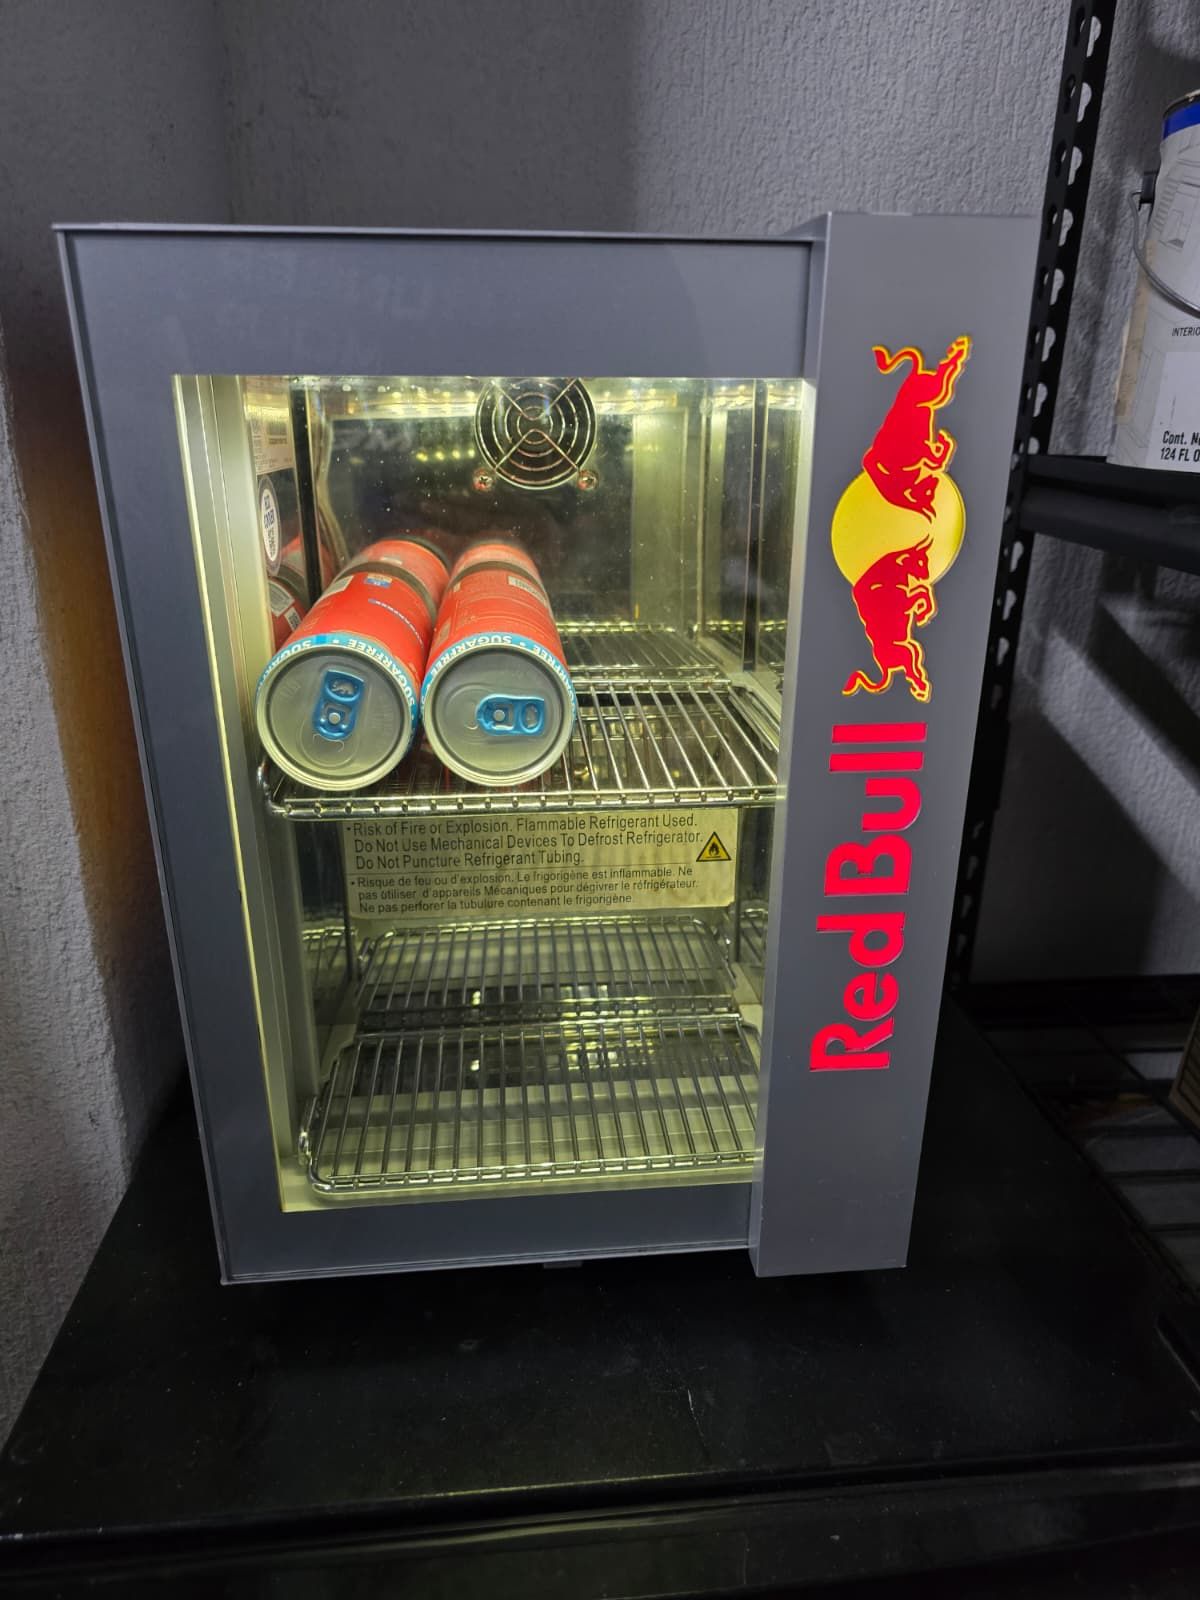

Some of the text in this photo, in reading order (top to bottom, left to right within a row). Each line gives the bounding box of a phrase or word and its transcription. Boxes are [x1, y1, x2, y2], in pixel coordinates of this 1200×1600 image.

[1162, 430, 1188, 444] Cont.
[1160, 448, 1176, 460] 124
[1178, 448, 1190, 462] FL
[430, 635, 513, 677] SUGARFREE
[348, 638, 415, 706] SUGARFREE
[354, 814, 697, 836] Risk of Fire or Explosion. Flammable Refrigerant Used.
[354, 830, 704, 853] Do Not Use Mechanical Devices To Defrost Refrigerator.
[356, 850, 584, 870] Do Not Puncture Refrigerant Tubing.
[358, 876, 395, 889] Risque
[398, 876, 412, 886] de
[414, 875, 432, 886] feu
[434, 877, 448, 885] ou
[592, 870, 608, 879] est
[678, 866, 693, 876] Ne
[358, 892, 378, 900] pas
[550, 884, 574, 895] pour
[622, 880, 630, 890] le
[810, 721, 928, 1072] Red Bull
[360, 902, 375, 912] Ne
[378, 904, 398, 914] pas
[402, 900, 444, 914] perforer
[448, 900, 456, 910] la
[460, 899, 504, 909] tubulure
[508, 897, 560, 906] contenant
[564, 896, 572, 904] le
